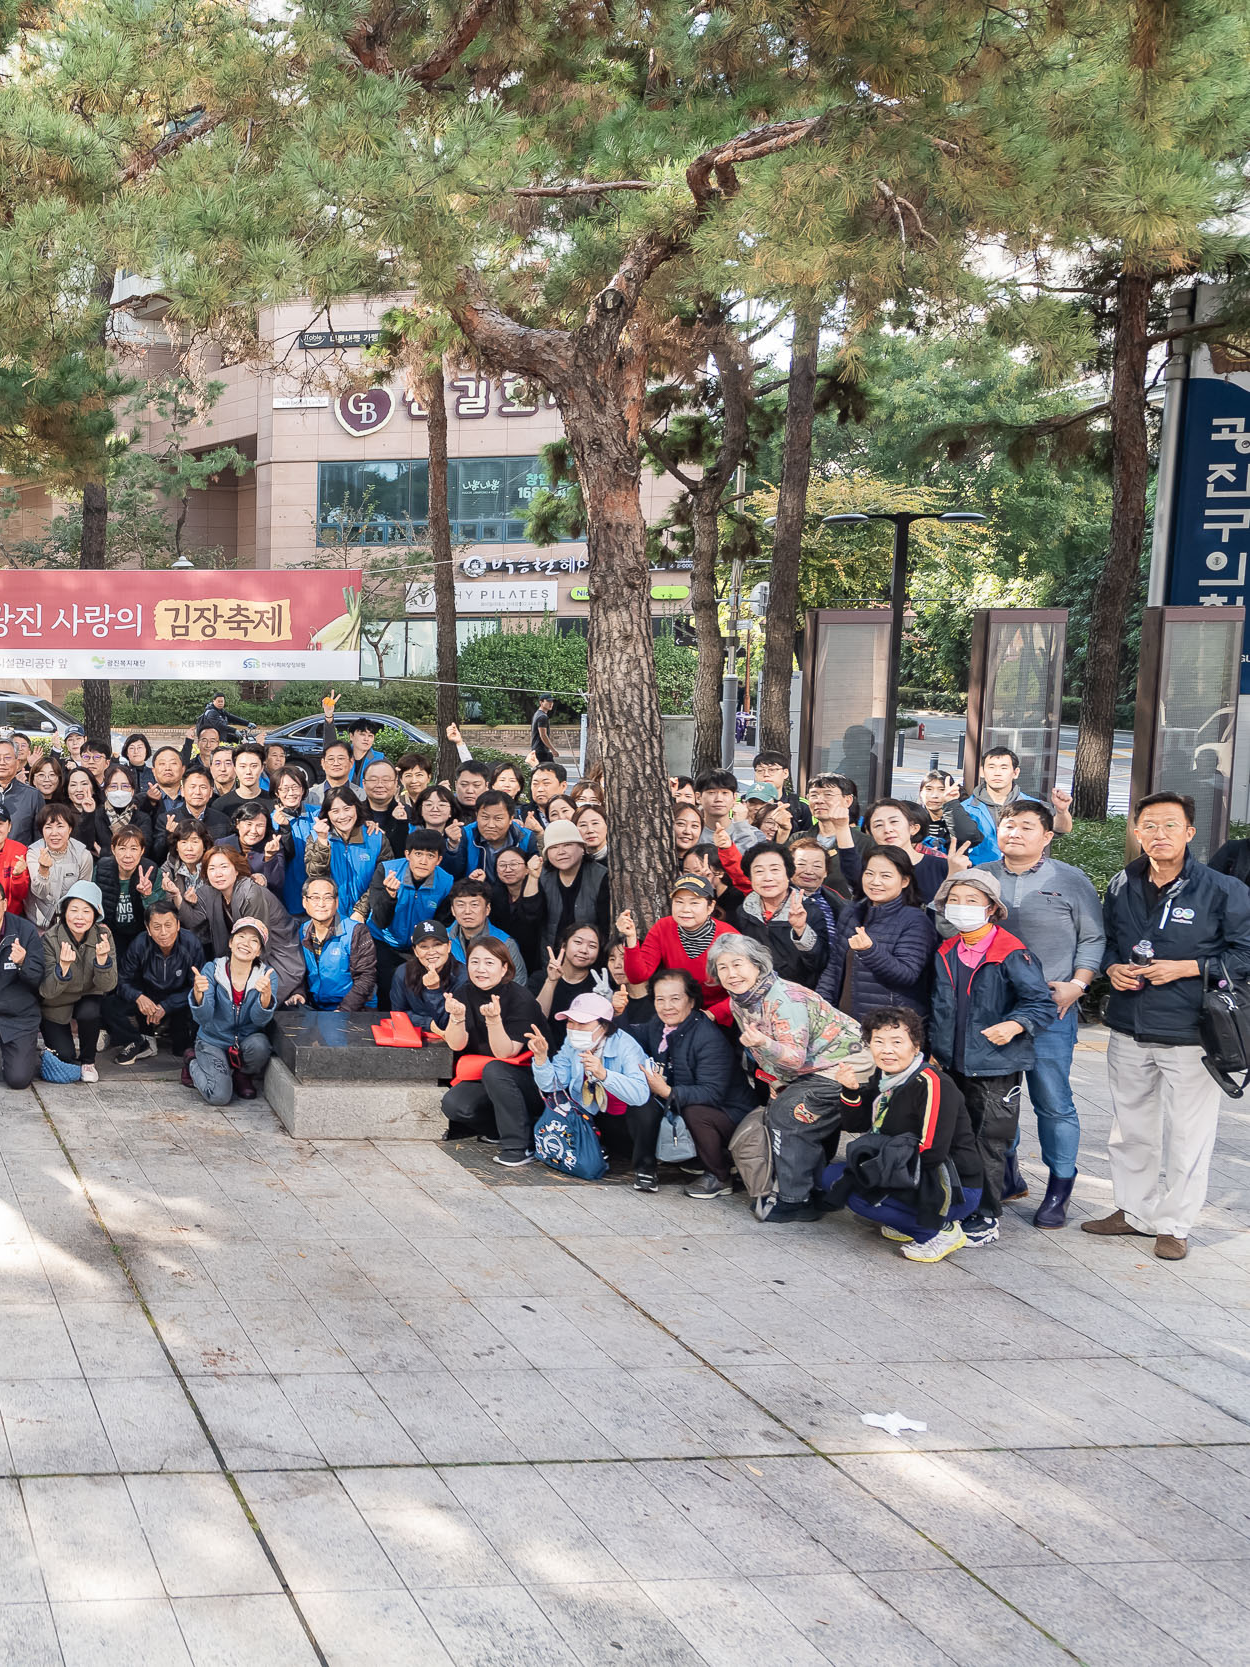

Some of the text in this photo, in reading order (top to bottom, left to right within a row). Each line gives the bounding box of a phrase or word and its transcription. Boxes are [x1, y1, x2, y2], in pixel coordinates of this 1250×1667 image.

[481, 589, 549, 599] PILATES
[51, 603, 143, 637] 사랑의
[164, 604, 283, 637] 김장축제
[58, 658, 68, 669] 앞
[107, 659, 146, 669] 광진복지재단
[116, 902, 133, 914] NG
